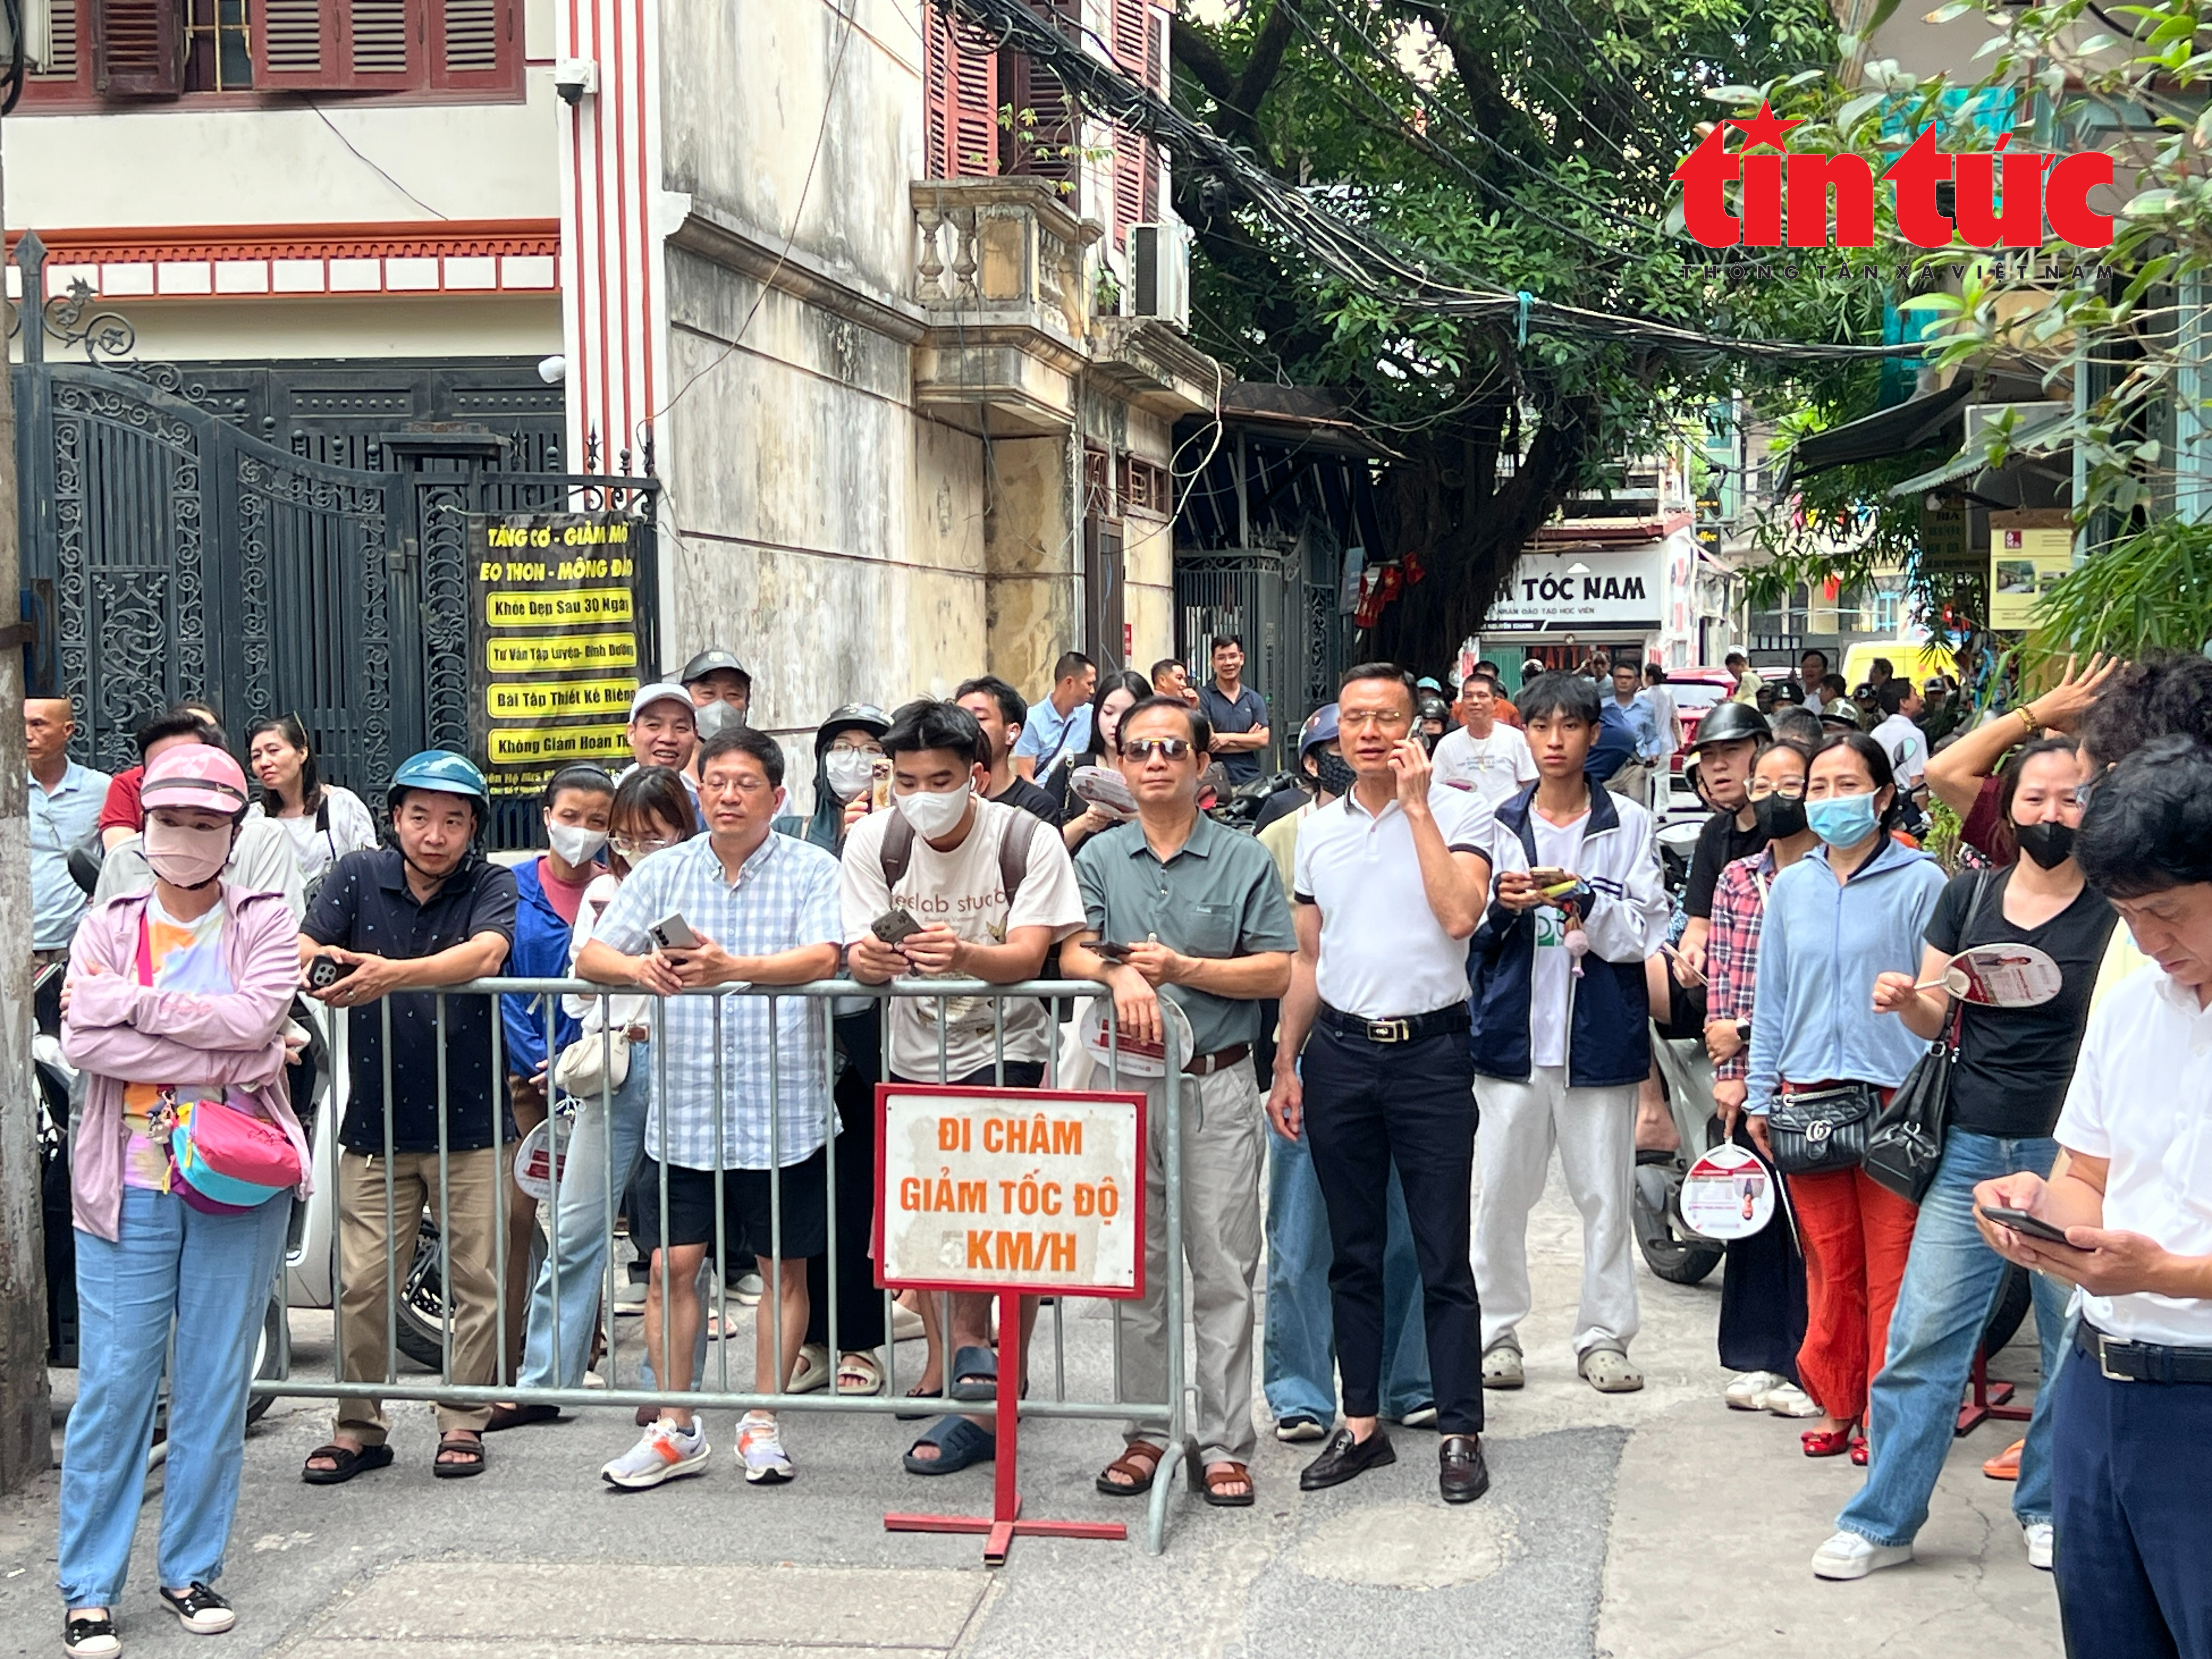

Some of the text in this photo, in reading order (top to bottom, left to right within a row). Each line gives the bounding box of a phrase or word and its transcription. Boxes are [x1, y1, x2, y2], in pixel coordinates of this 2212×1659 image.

[530, 525, 551, 548] CƠ
[479, 562, 503, 582] EO
[506, 562, 545, 582] THON
[557, 556, 608, 581] MÔNG
[1522, 572, 1575, 601] TÓC
[1583, 577, 1645, 600] NAM
[556, 600, 581, 614] Sau
[584, 598, 599, 612] 30
[498, 738, 540, 754] Không
[938, 1118, 971, 1153] ĐI
[900, 1166, 1119, 1226] GIẢM TỐC ĐỘ
[967, 1230, 1076, 1272] KM/H
